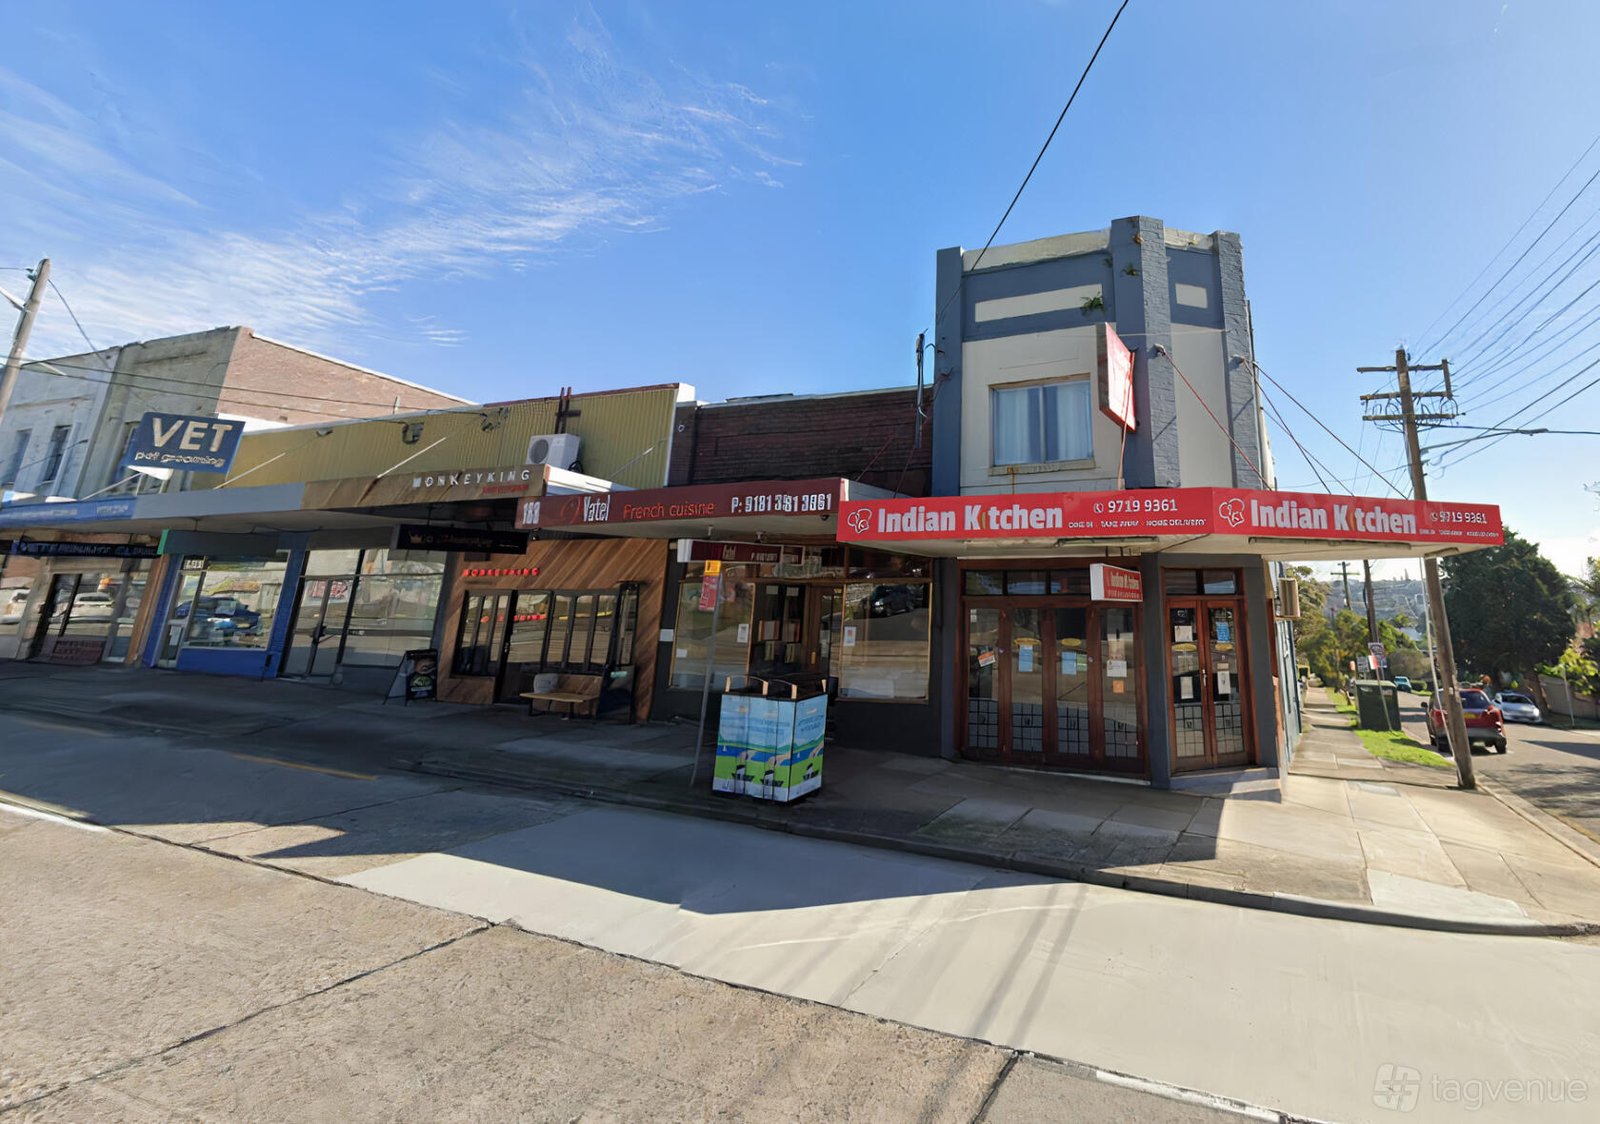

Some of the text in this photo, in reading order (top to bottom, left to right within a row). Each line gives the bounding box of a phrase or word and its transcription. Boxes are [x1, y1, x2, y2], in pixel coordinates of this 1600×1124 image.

[152, 417, 233, 452] VET
[135, 451, 225, 467] pet grooming
[583, 494, 611, 521] Vatel
[623, 502, 665, 519] French
[669, 501, 715, 516] cuisine
[877, 505, 956, 532] Indian
[1108, 499, 1178, 513] 9719 9361
[1251, 499, 1328, 530] Indian
[1440, 511, 1462, 522] 9719
